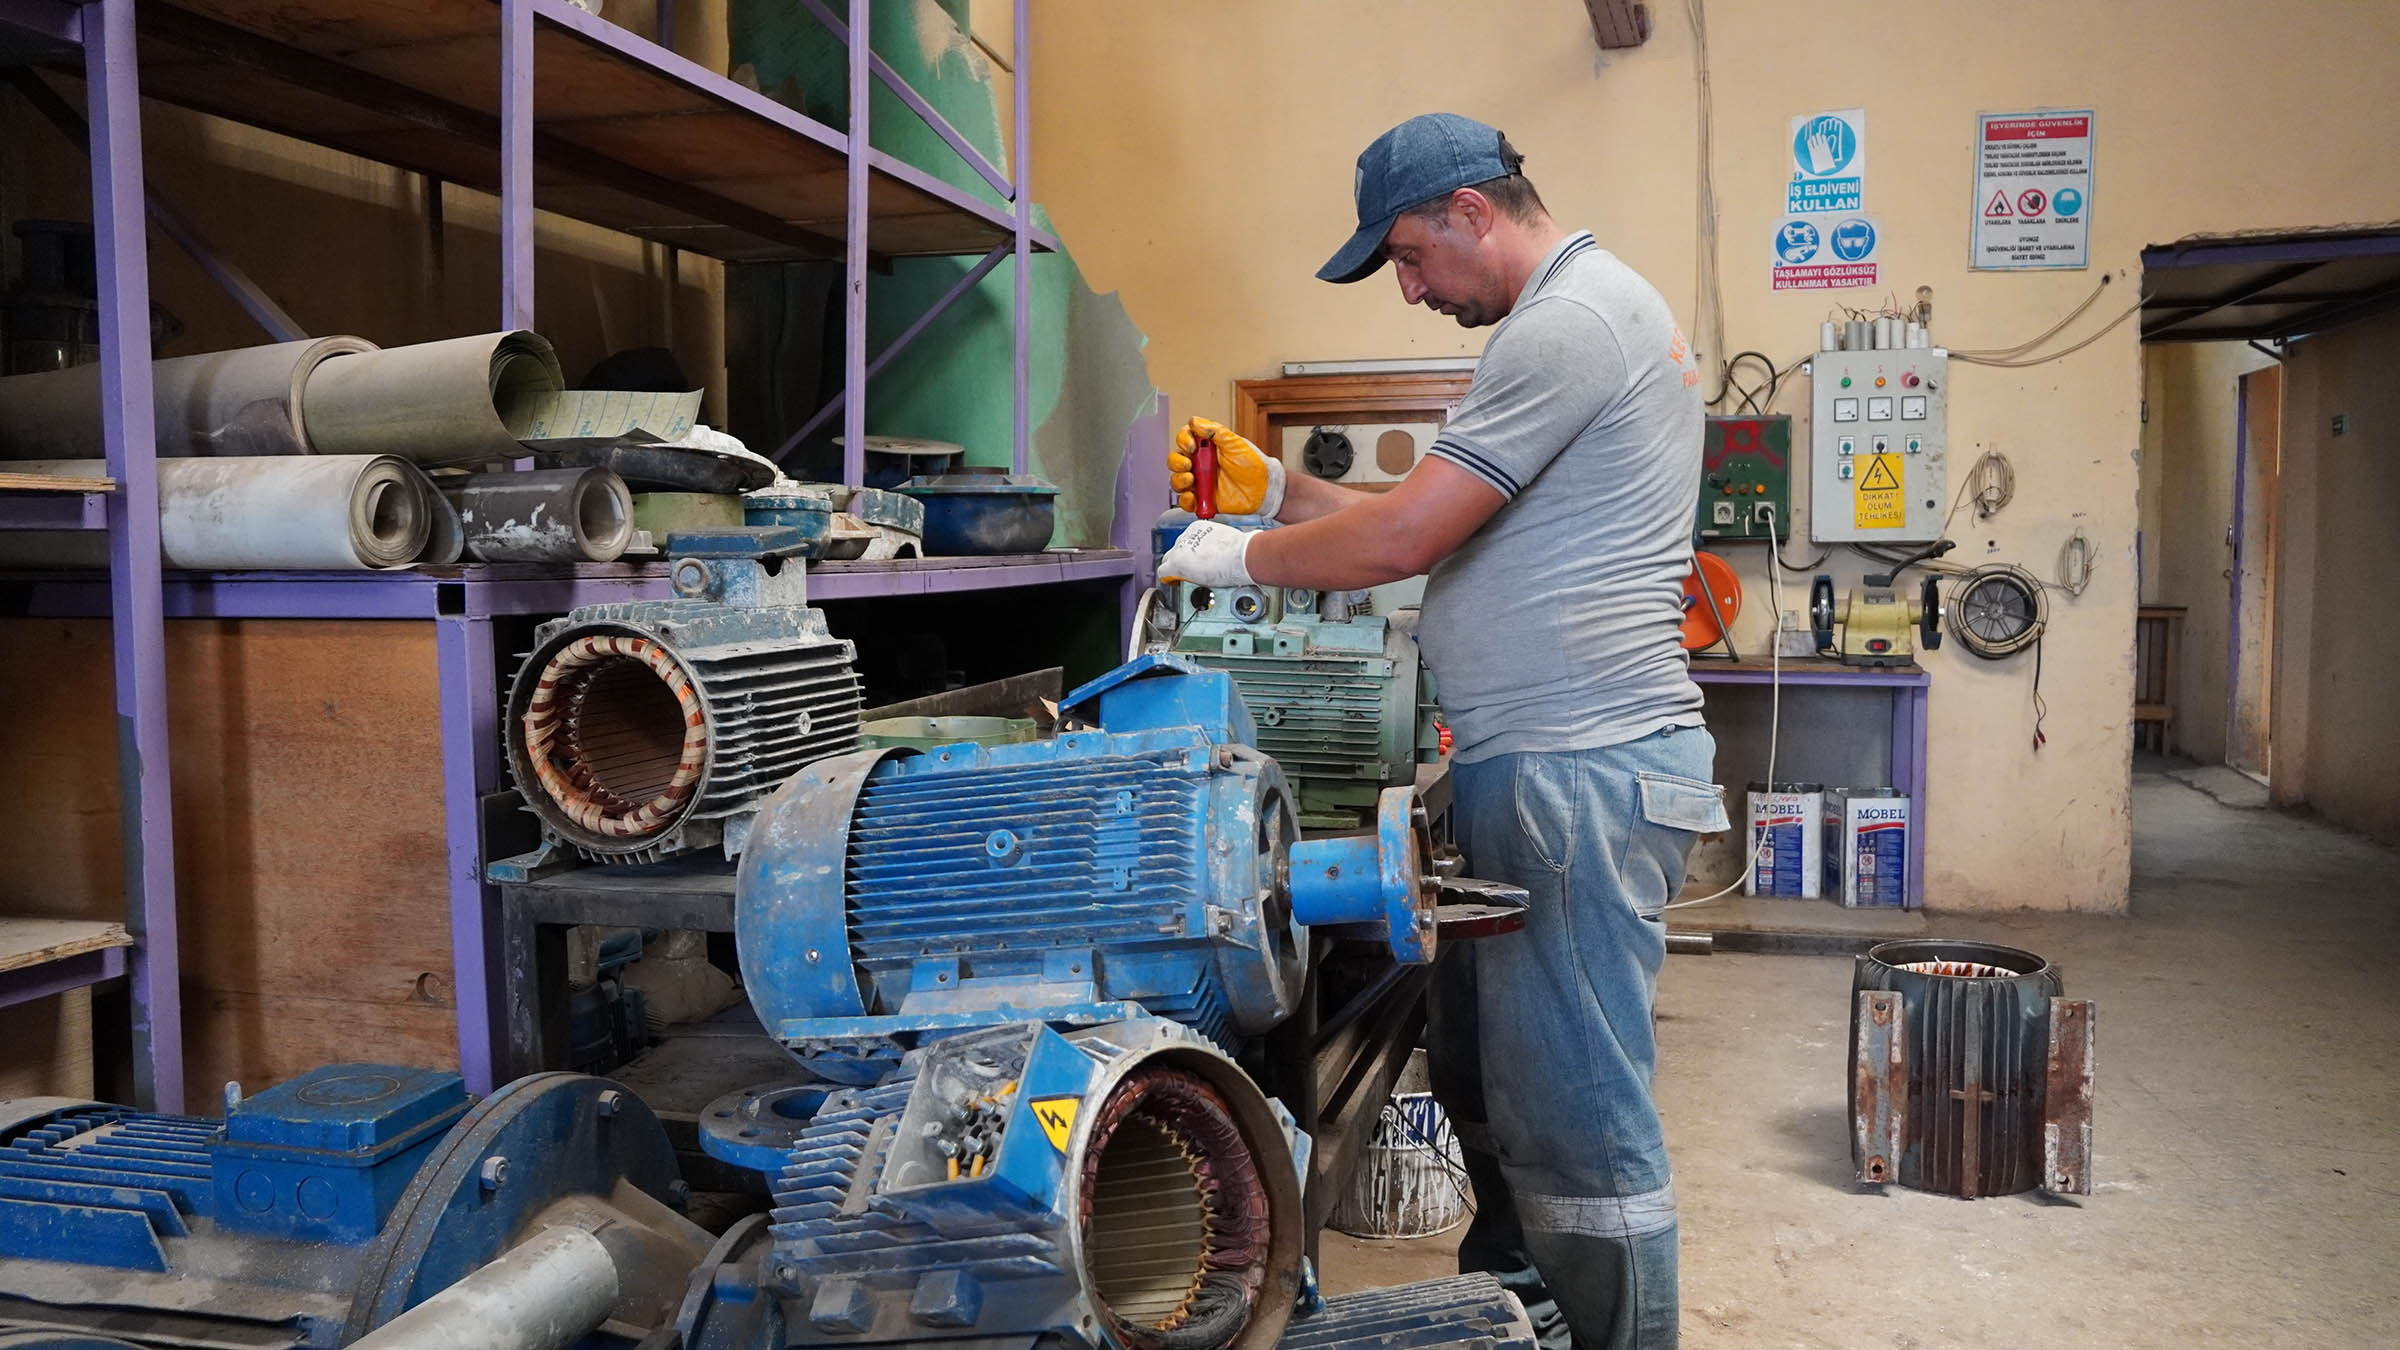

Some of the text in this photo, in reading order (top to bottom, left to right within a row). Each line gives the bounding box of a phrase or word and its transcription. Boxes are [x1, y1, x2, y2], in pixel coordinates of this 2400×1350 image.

[1790, 179, 1859, 199] İŞ ELDİVENİ
[1790, 198, 1859, 211] KULLAN
[1774, 265, 1875, 280] TAŞLAMAYI GÖZLÜKSÜZ
[1776, 279, 1828, 289] KULLANMAK
[1857, 808, 1905, 819] MOBEL
